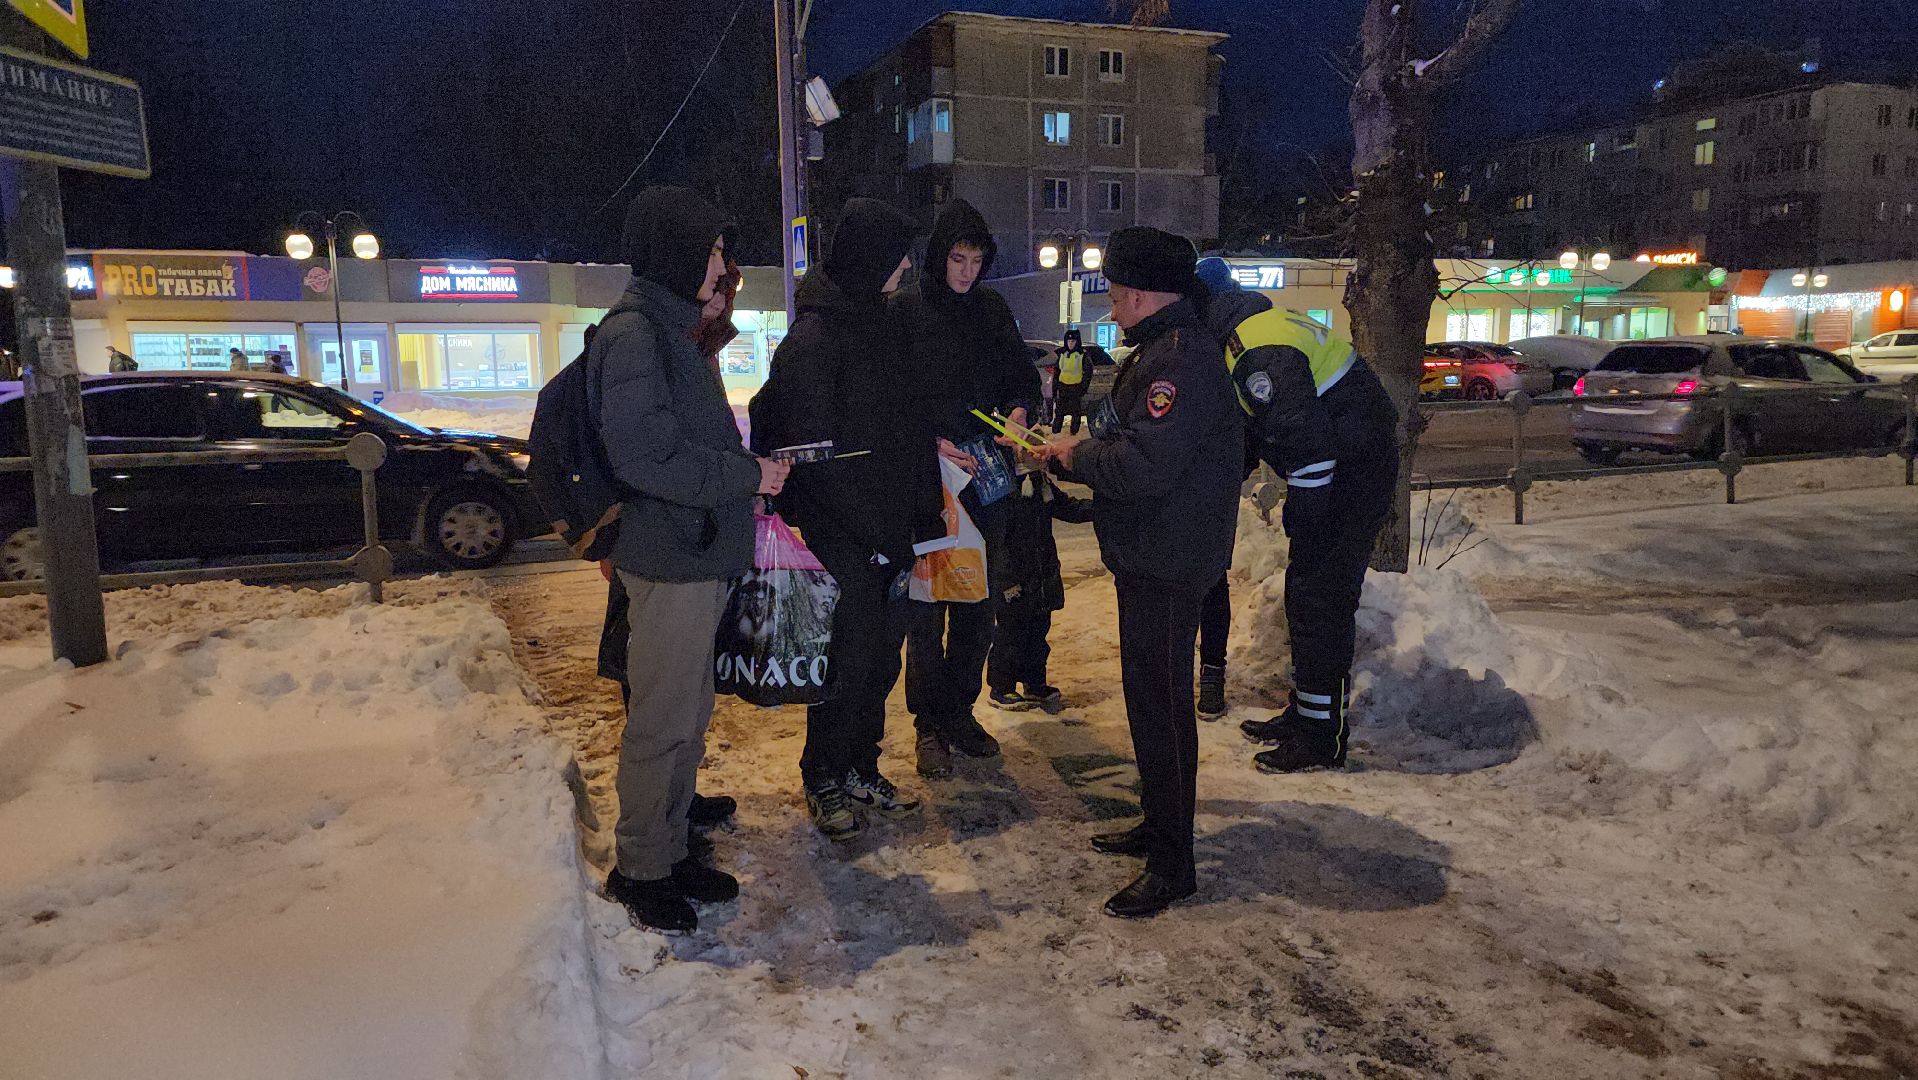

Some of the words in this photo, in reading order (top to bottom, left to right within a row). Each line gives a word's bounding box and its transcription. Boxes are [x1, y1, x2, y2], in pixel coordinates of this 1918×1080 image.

[103, 264, 157, 296] PRO
[158, 278, 236, 296] ТАБАК
[421, 276, 450, 293] ДОМ
[456, 277, 517, 292] МЯСНИКА
